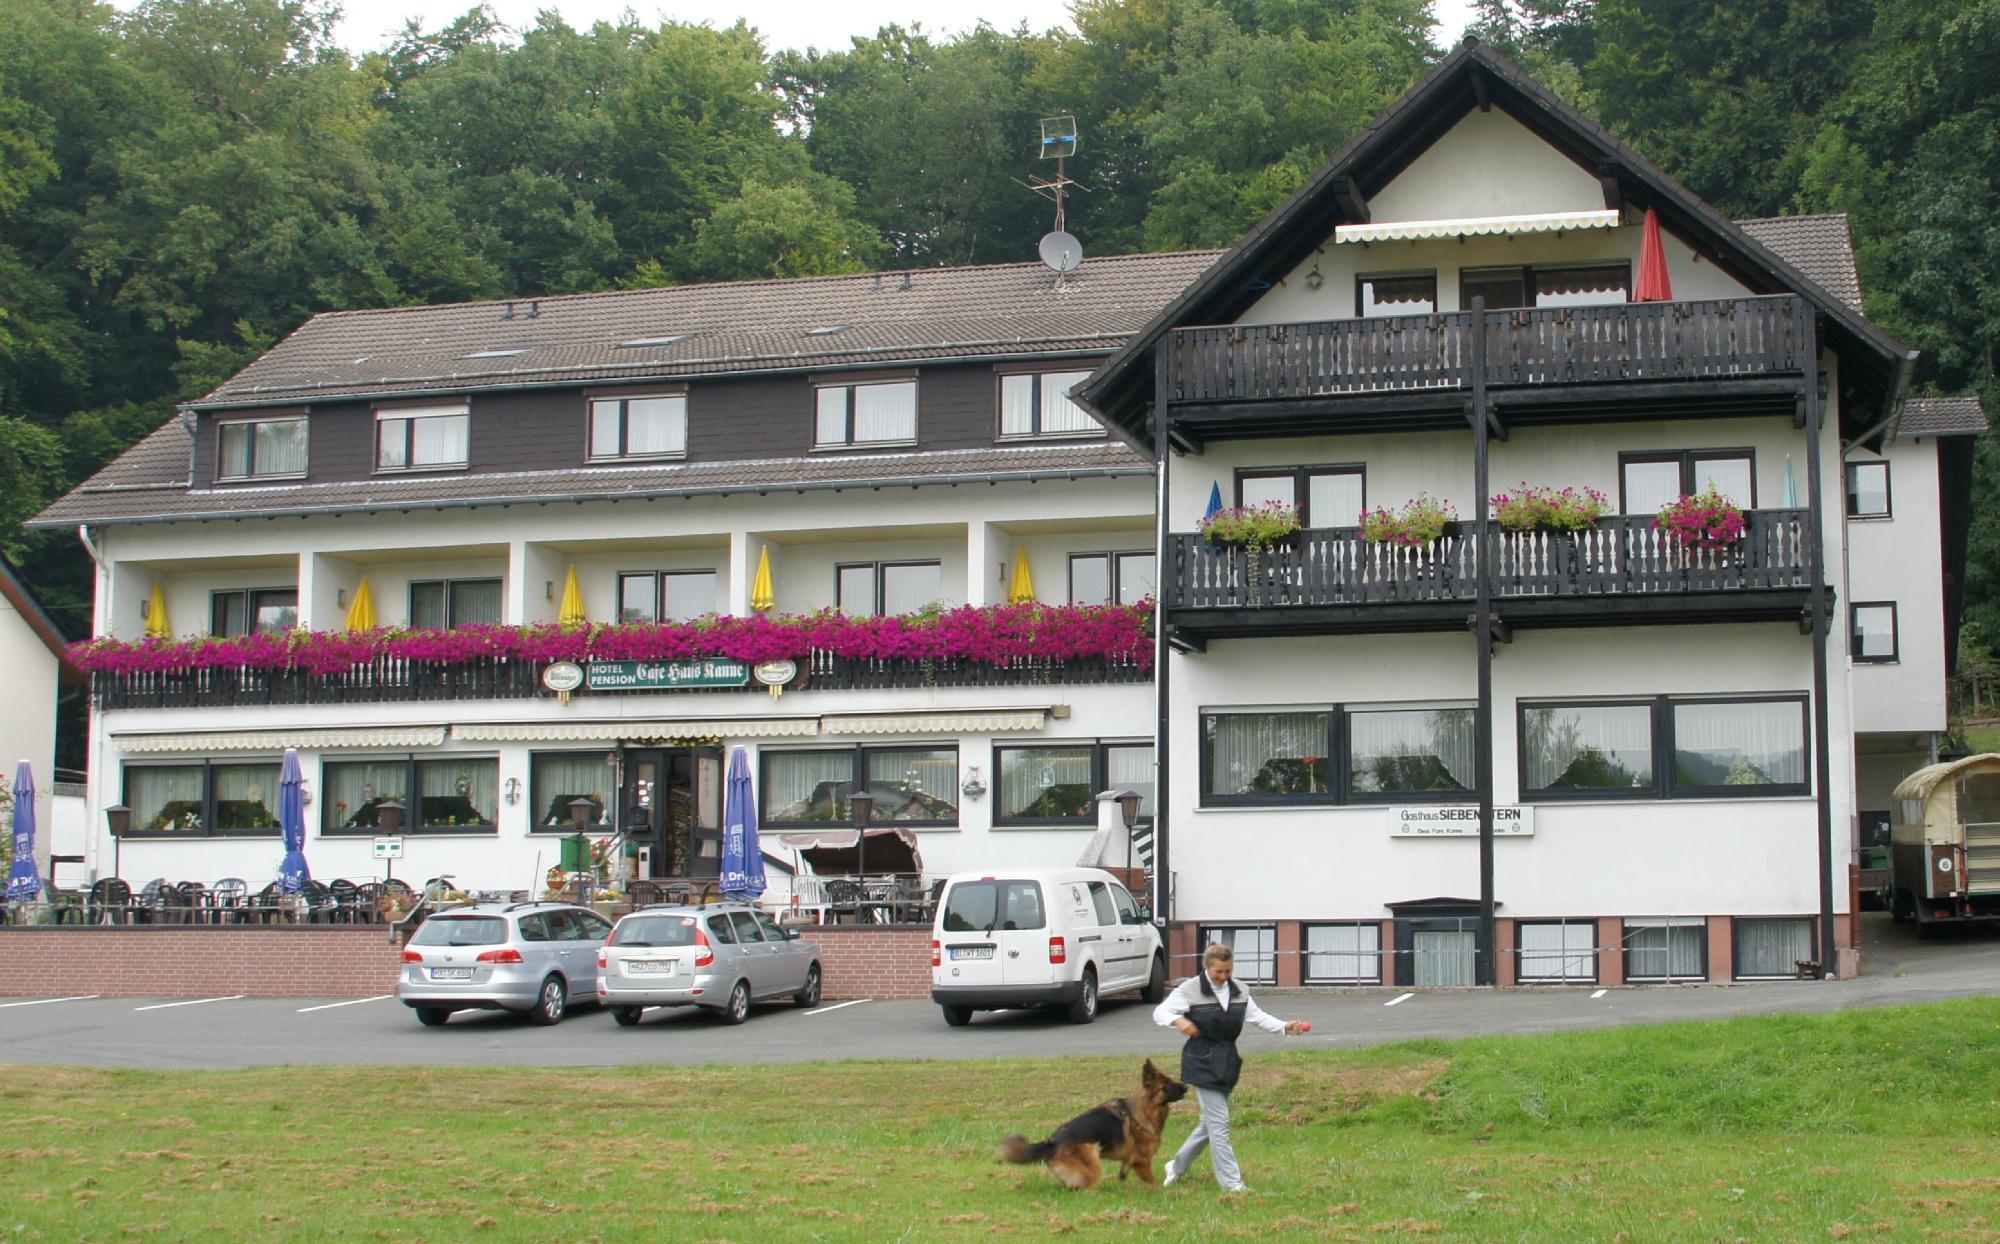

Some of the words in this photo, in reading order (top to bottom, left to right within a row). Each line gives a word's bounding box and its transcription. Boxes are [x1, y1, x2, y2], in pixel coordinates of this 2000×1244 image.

[591, 664, 624, 673] HOTEL
[668, 661, 701, 685] Haus
[704, 661, 744, 679] Kanne
[591, 675, 637, 685] PENSION
[1401, 809, 1439, 821] Gasthaus
[1439, 807, 1521, 821] SIEBENTERN
